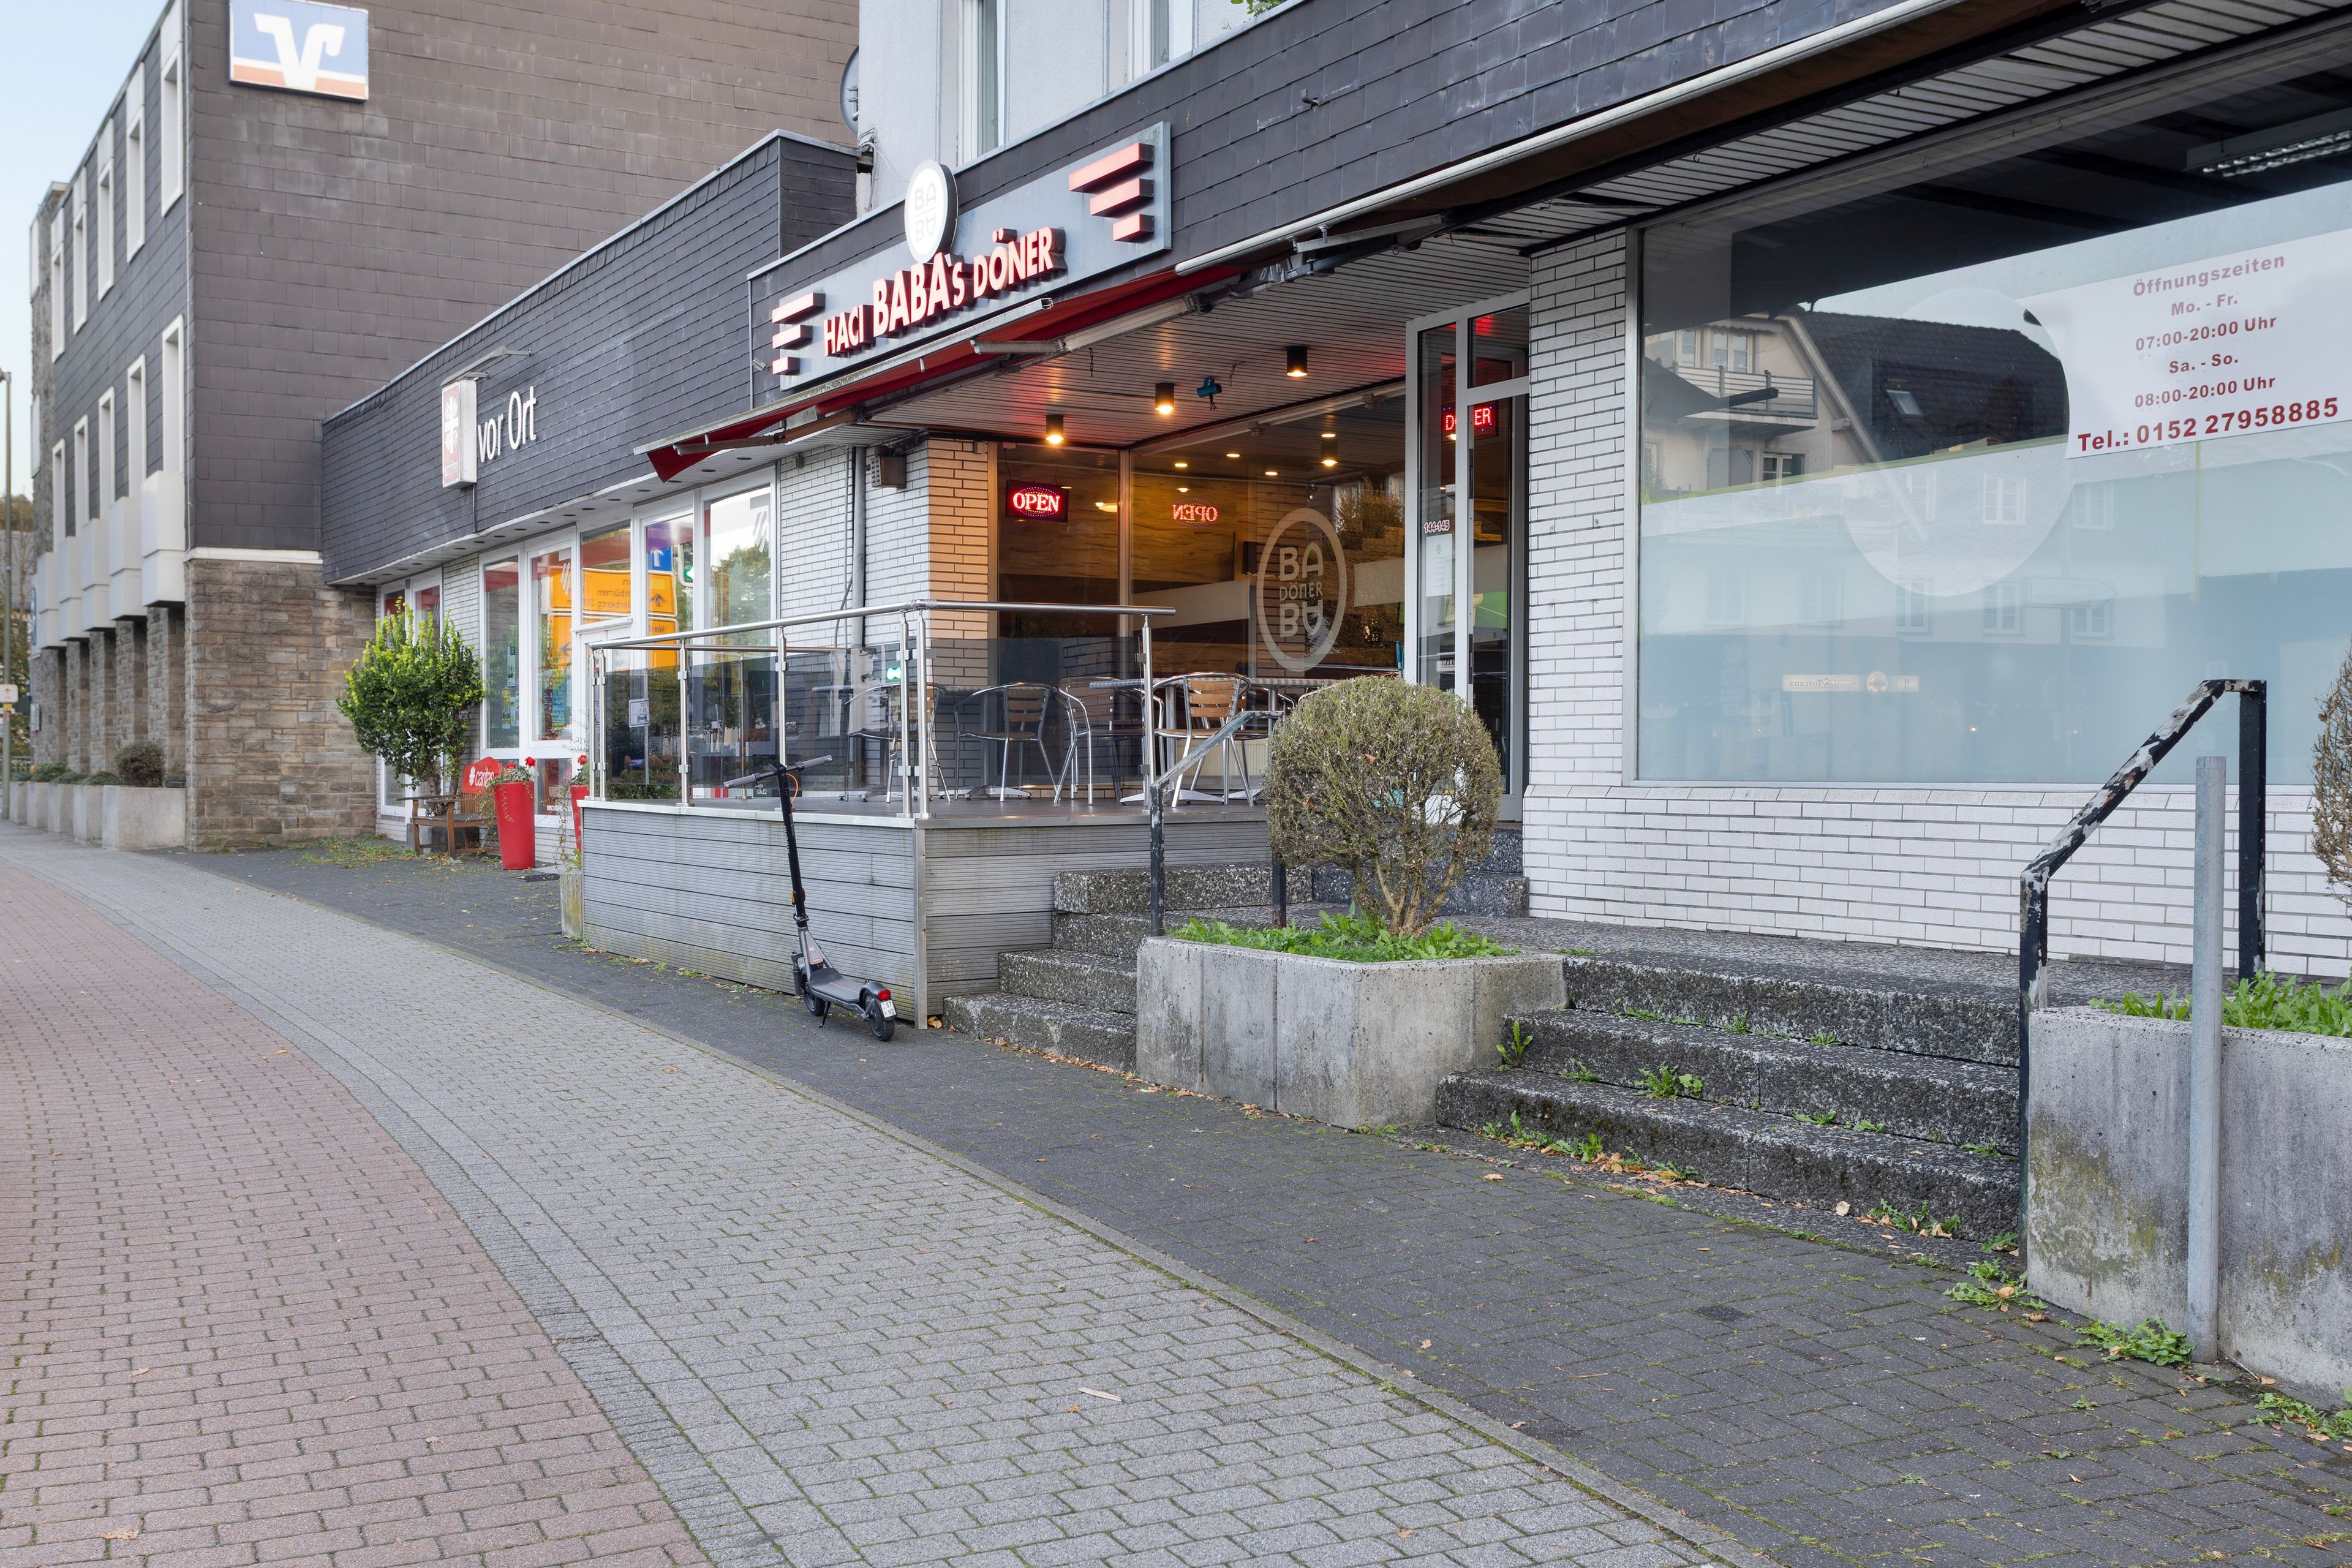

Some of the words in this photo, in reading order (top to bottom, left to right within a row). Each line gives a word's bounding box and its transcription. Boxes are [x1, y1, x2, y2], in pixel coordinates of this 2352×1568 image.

[824, 304, 864, 356] HACI
[973, 227, 1054, 298] DÖNER
[2133, 256, 2285, 296] Öffnungszeiten
[2171, 302, 2200, 316] Mo.
[2217, 293, 2238, 307] Fr.
[2136, 321, 2238, 351] 07:00-20:00
[2244, 315, 2277, 332] Uhr
[2169, 360, 2195, 374] Sa.
[2211, 353, 2238, 368] So.
[2135, 380, 2237, 408] 08:00-20:00
[2244, 375, 2275, 391] Uhr
[478, 413, 503, 463] vor
[508, 386, 537, 450] Ort
[2078, 430, 2128, 451] Tel.:
[2136, 418, 2196, 443] 0152
[2205, 397, 2339, 434] 27958885
[1013, 492, 1060, 513] OPEN
[1424, 520, 1450, 533] 144-145
[1280, 541, 1323, 581] BA
